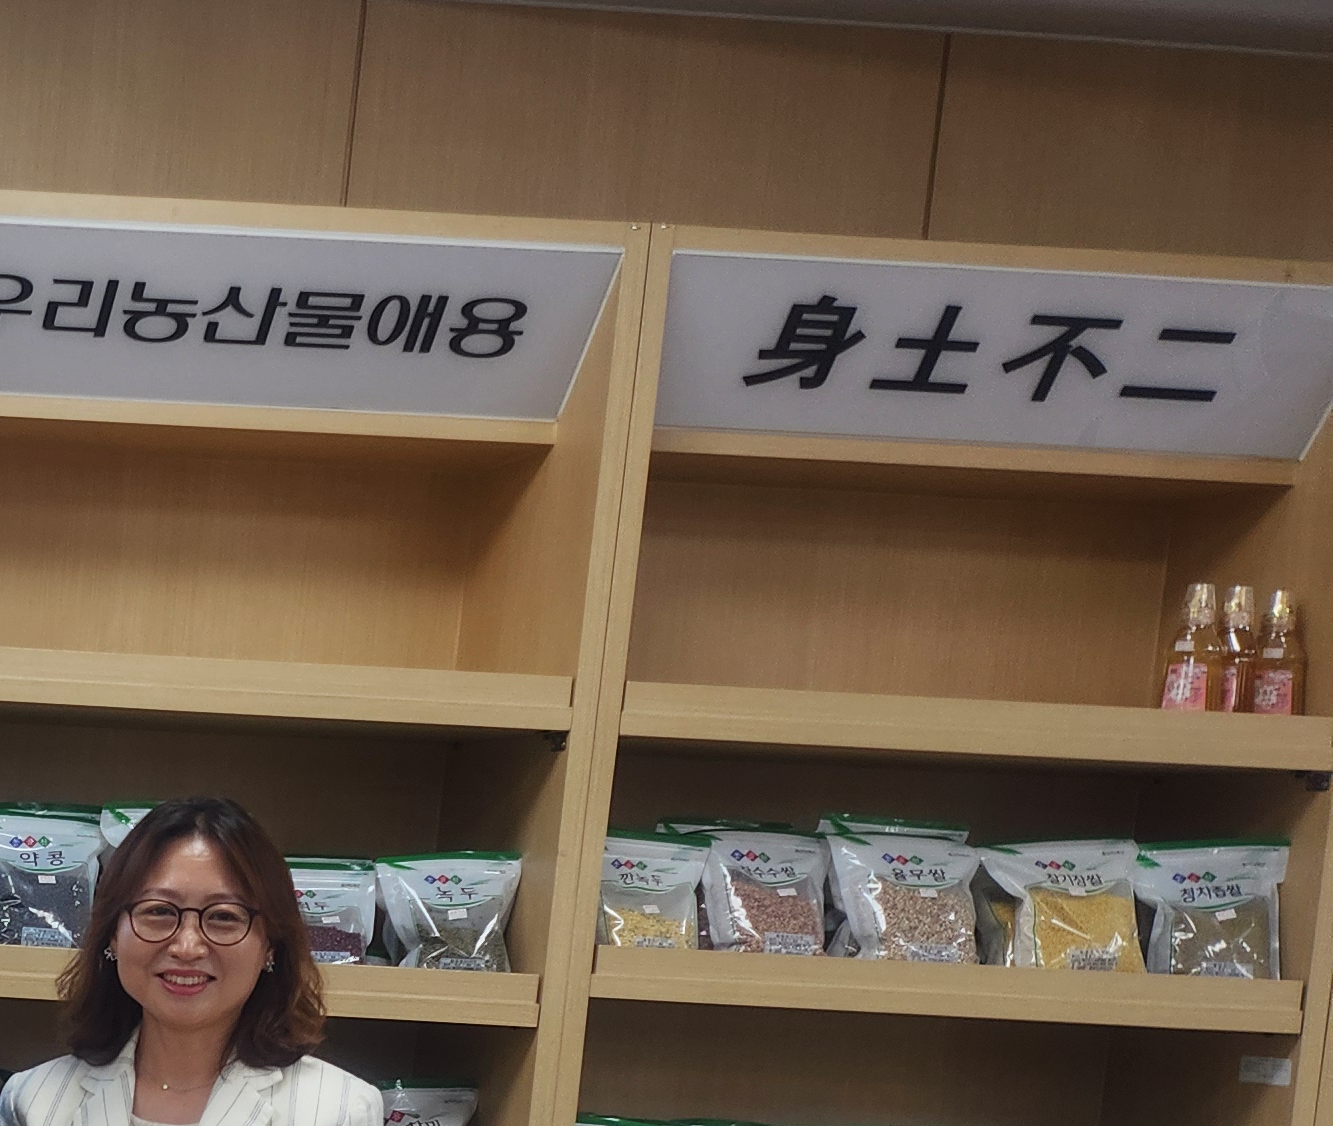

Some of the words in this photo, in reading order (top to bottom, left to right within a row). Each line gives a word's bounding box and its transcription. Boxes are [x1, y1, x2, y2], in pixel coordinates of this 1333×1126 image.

[743, 293, 1237, 404] 身土不二
[19, 850, 66, 867] 약콩
[436, 887, 478, 902] 녹두
